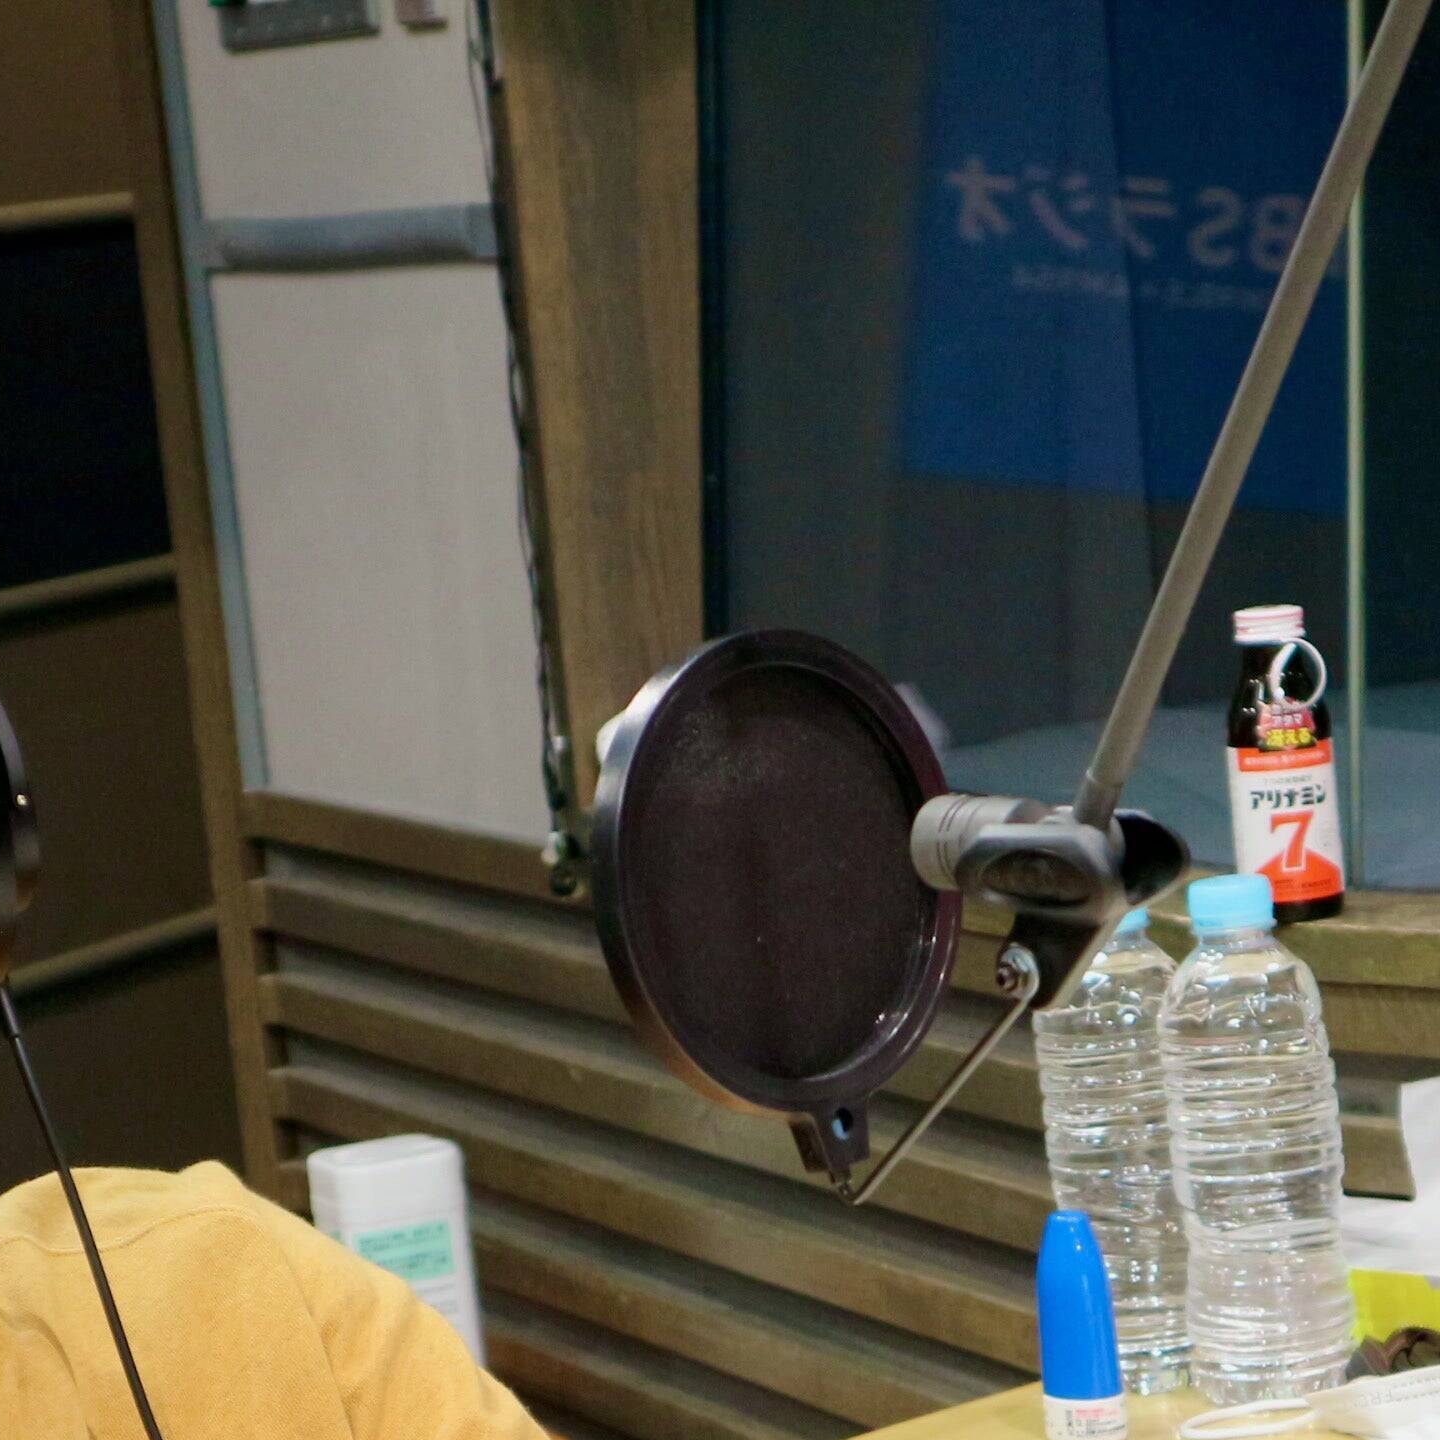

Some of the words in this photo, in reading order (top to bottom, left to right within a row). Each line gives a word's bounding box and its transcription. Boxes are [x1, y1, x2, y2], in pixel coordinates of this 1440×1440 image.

[1250, 783, 1326, 810] アリナミン
[1271, 810, 1314, 873] 7
